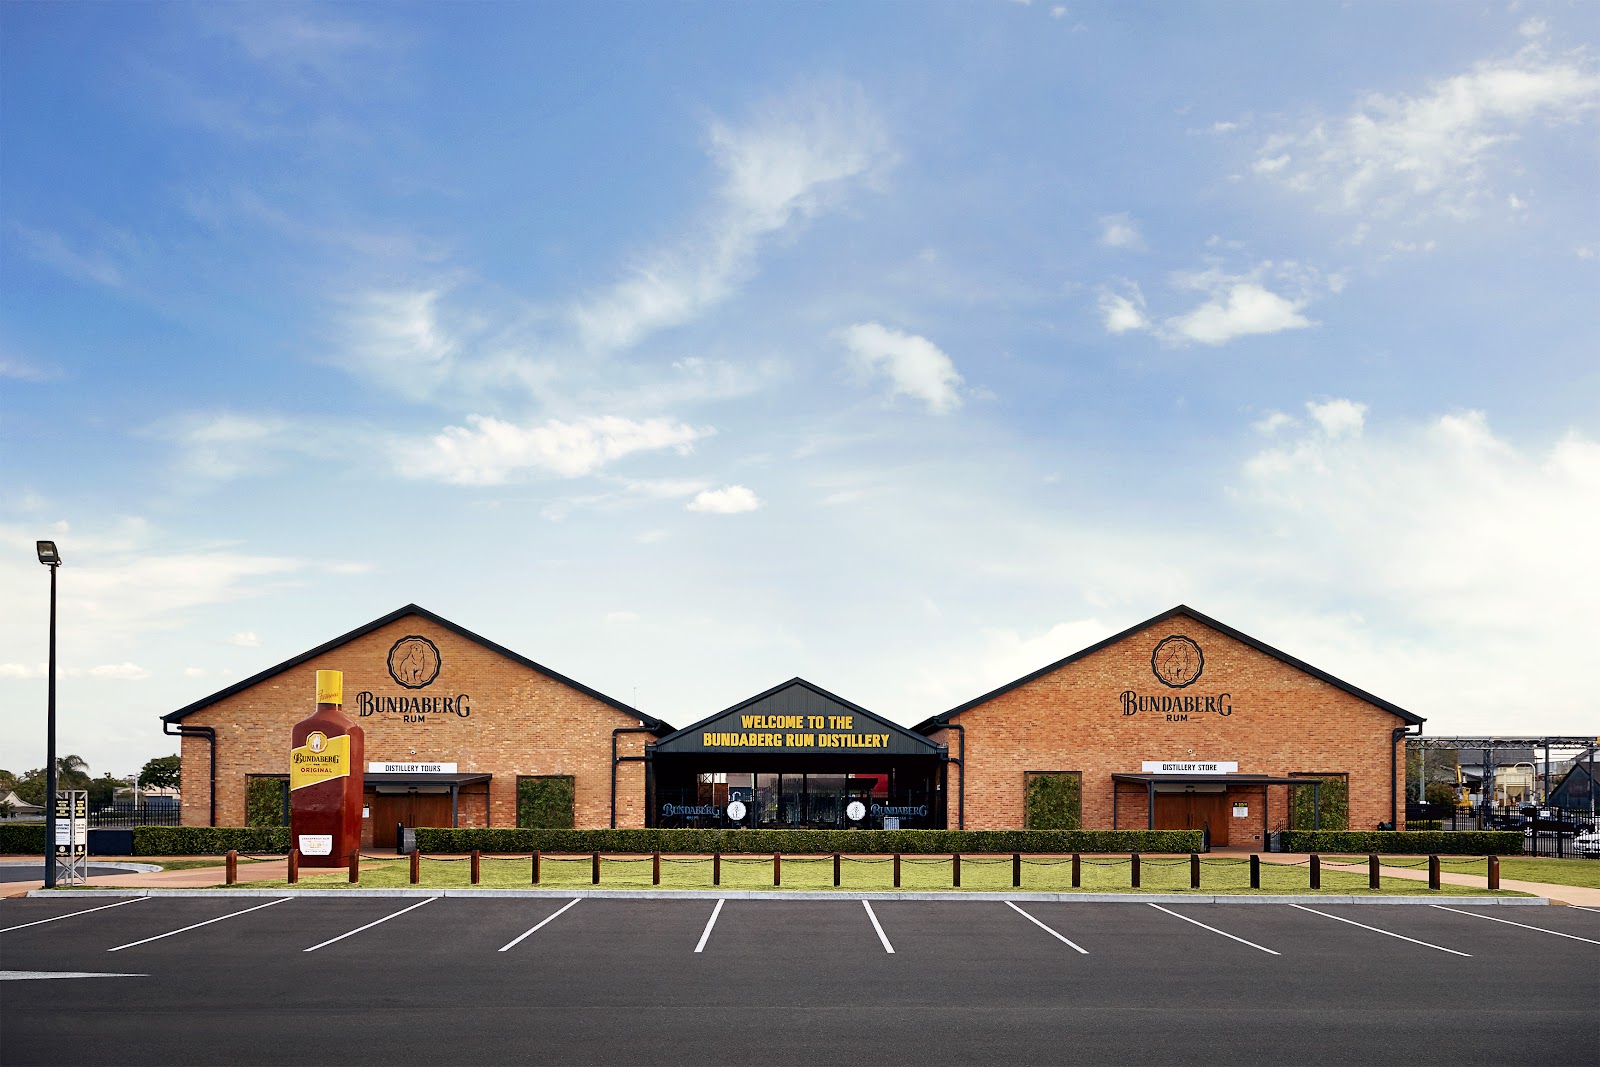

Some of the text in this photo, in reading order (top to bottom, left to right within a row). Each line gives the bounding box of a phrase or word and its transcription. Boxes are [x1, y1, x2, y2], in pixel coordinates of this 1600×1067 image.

[356, 691, 470, 718] BUNDABERG
[1119, 690, 1232, 717] BUNDABERG
[403, 715, 425, 723] RUM
[741, 715, 853, 730] WELCOME TO THE
[1166, 714, 1188, 722] RUM
[703, 732, 890, 748] BUNDABERG RUM DISTILLERY
[293, 752, 339, 764] BUNDABERG
[385, 764, 418, 772] DISTILLERY
[662, 803, 720, 817] BUNDABERG
[870, 803, 928, 817] BUNDABERG
